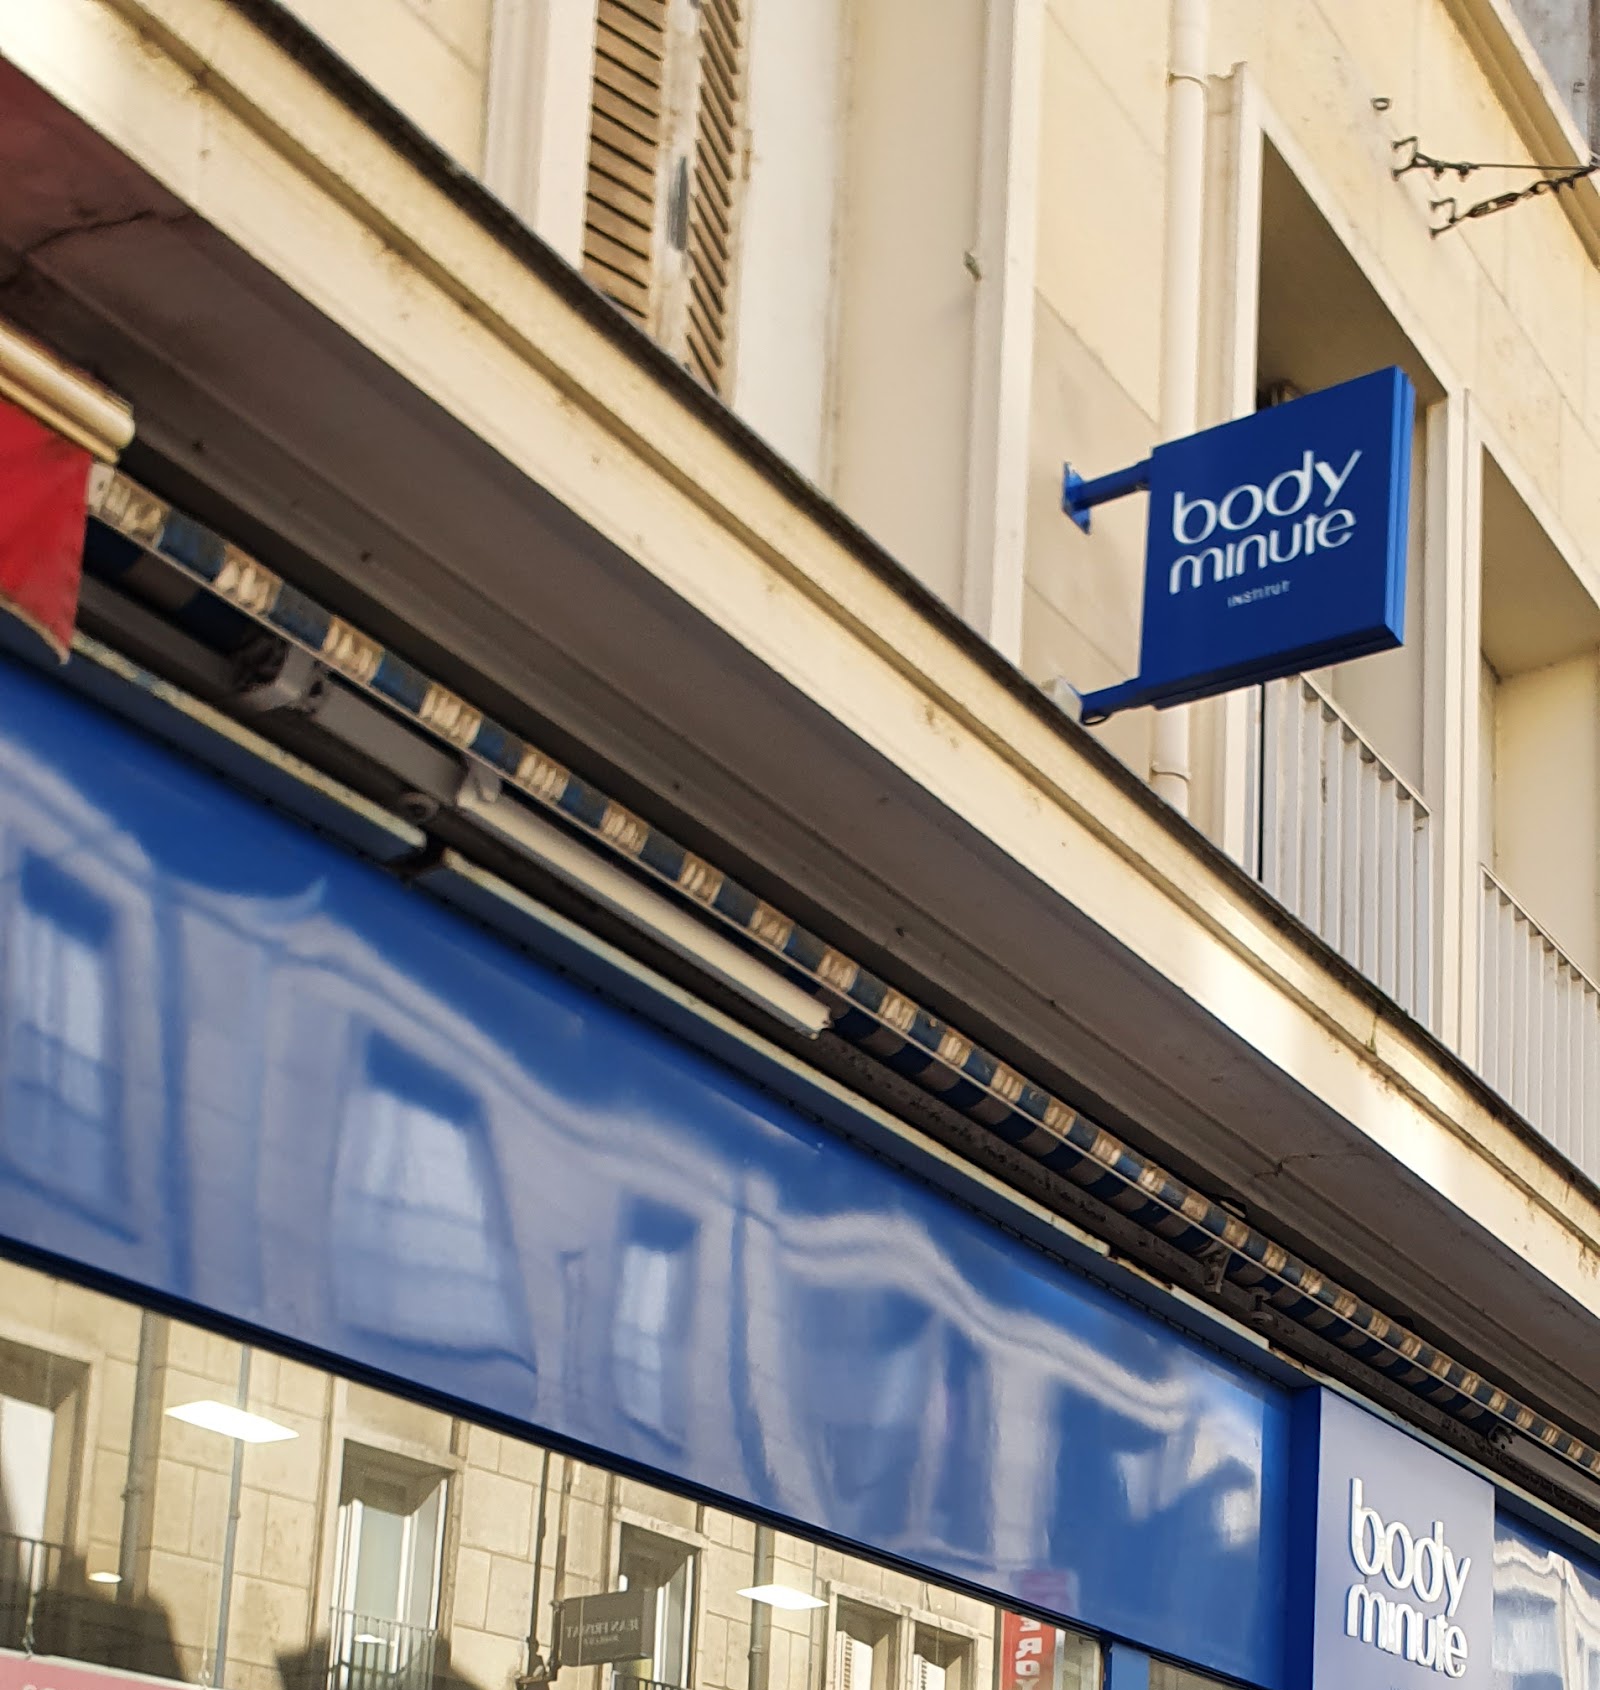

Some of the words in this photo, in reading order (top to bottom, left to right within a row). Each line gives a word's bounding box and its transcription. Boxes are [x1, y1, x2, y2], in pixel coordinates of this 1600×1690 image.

[1172, 450, 1362, 544] body
[1169, 508, 1357, 594] minute
[1227, 580, 1290, 608] INSTITUT
[1349, 1477, 1471, 1616] body
[1344, 1582, 1469, 1678] minute
